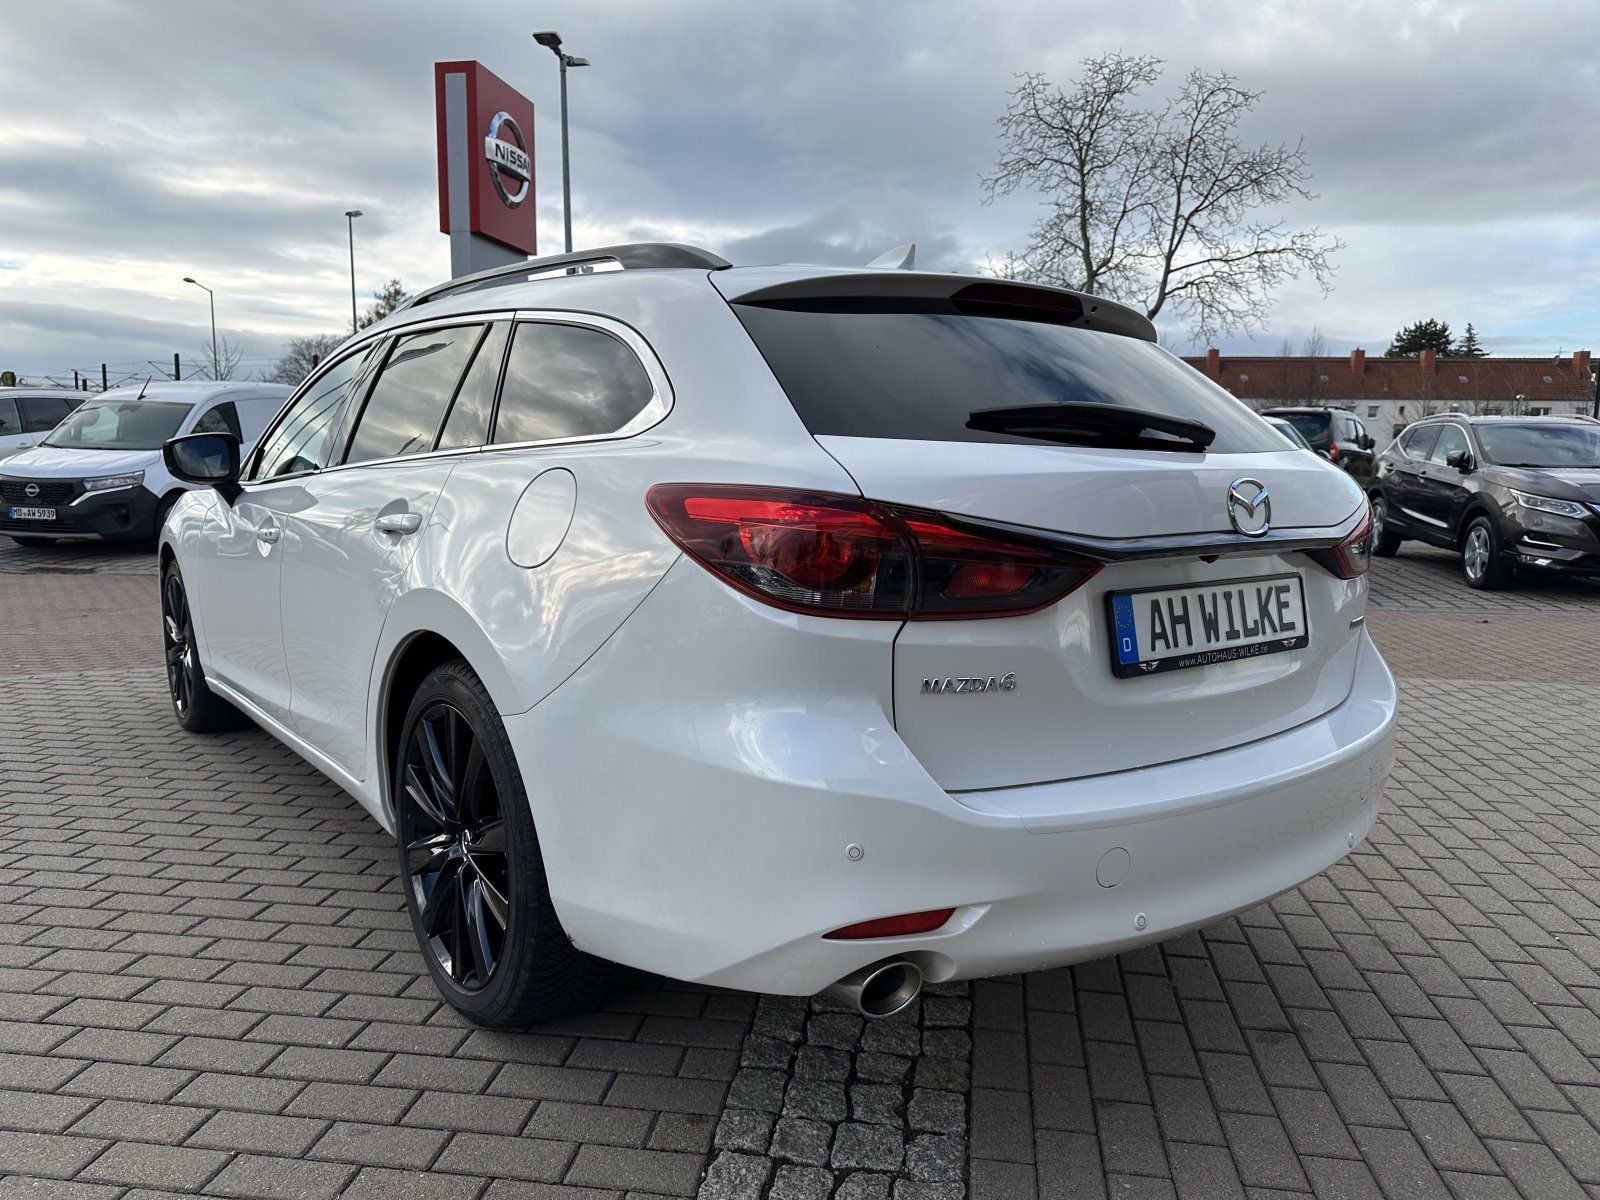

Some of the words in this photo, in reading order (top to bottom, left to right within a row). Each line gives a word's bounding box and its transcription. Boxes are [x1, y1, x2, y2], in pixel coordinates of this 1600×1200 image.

[12, 508, 22, 517] MD
[27, 509, 36, 518] AW
[37, 509, 55, 519] 5939
[1150, 595, 1193, 652] AH
[1198, 585, 1296, 644] WILKE
[1122, 637, 1132, 652] D
